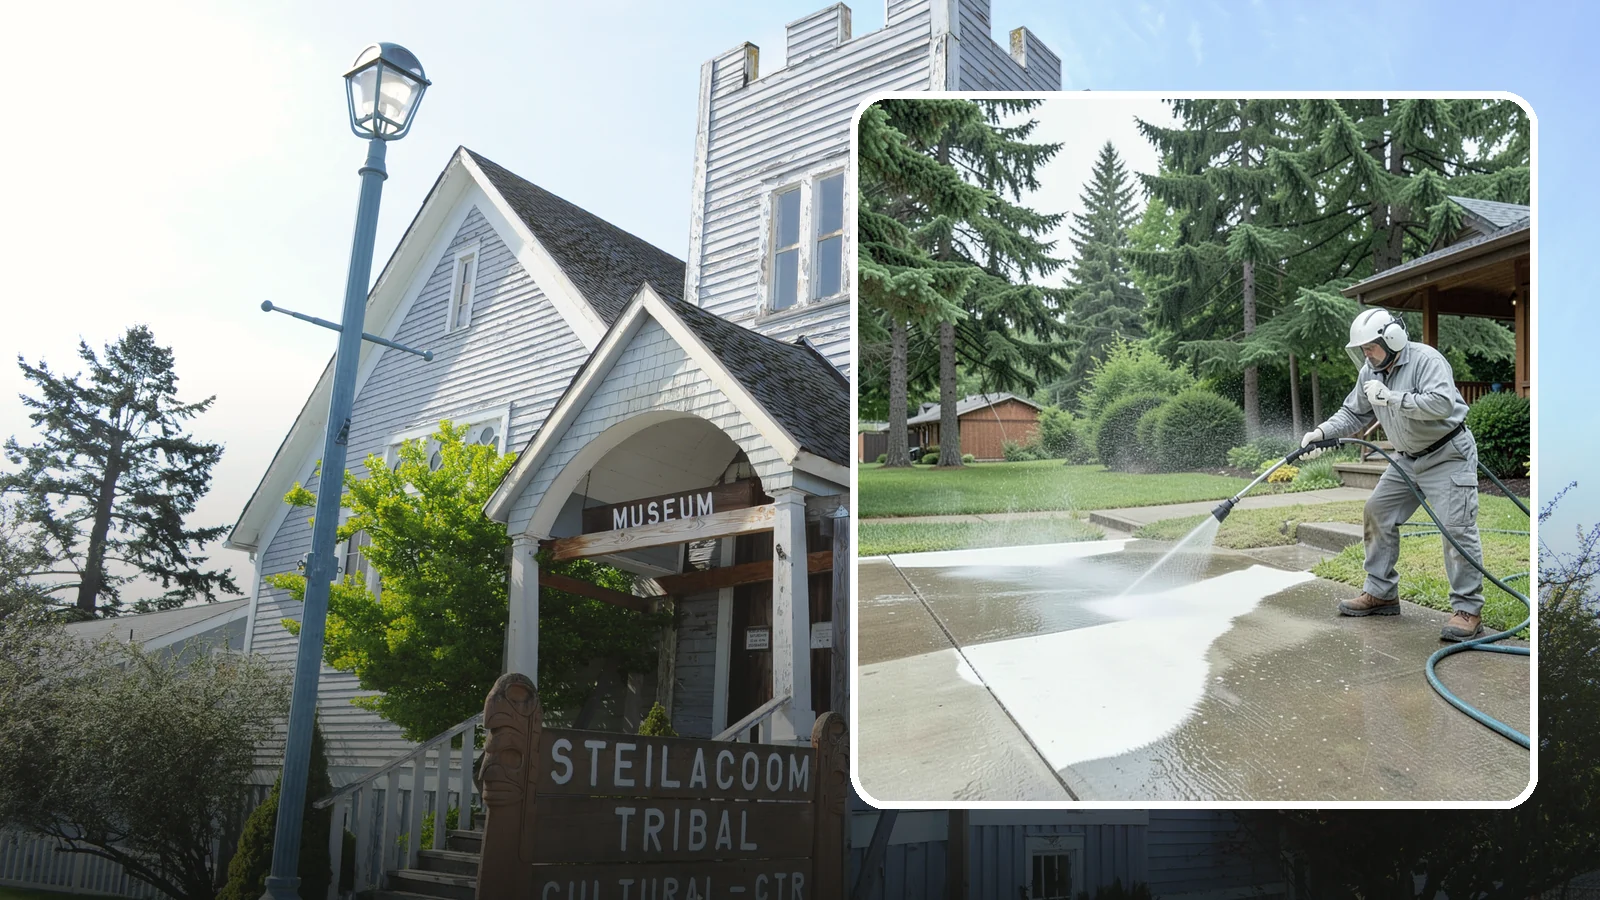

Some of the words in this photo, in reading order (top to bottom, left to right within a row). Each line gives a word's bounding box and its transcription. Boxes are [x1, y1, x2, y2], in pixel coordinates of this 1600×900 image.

[612, 491, 713, 531] MUSEUM
[550, 738, 809, 792] STEILACOOM
[615, 806, 758, 852] TRIBAL
